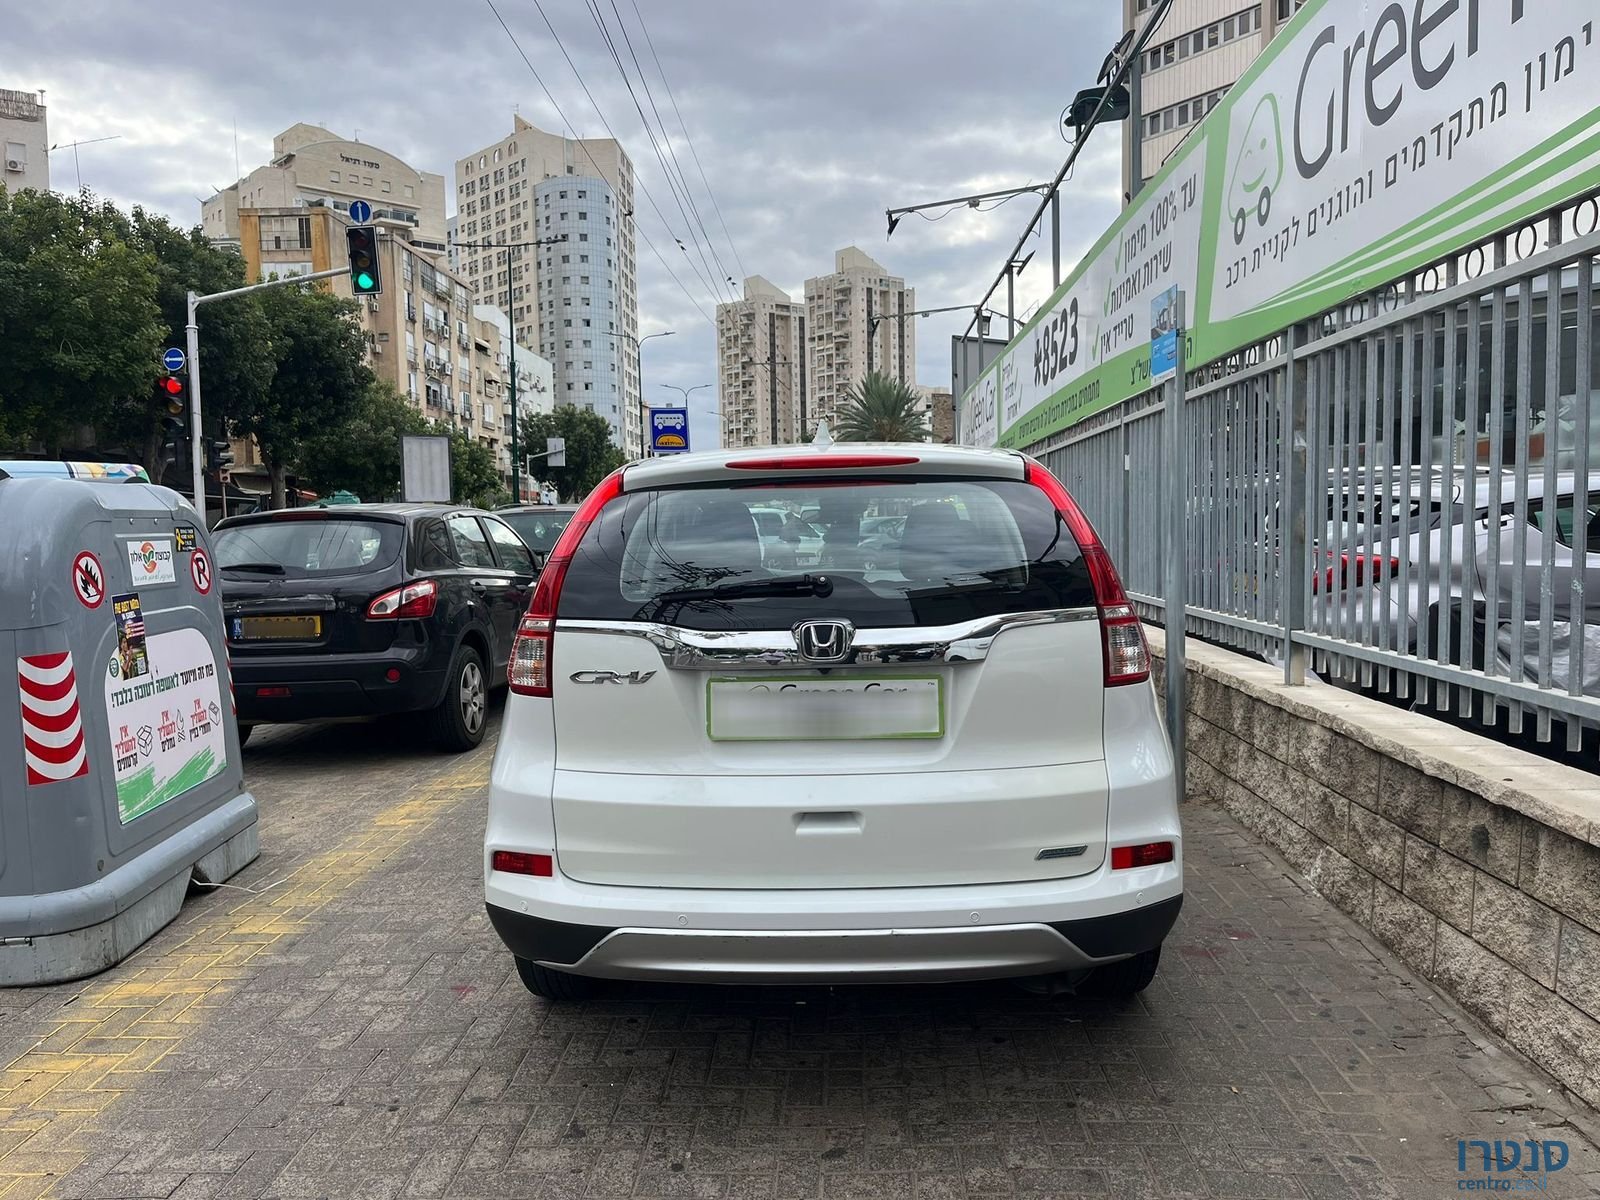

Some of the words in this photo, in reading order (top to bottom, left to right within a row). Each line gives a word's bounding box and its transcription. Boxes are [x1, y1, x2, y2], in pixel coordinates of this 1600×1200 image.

[1385, 81, 1507, 189] מתקדמים
[1181, 173, 1197, 212] עד
[1307, 169, 1373, 238] והוגנים
[1149, 189, 1177, 242] 100%
[1124, 223, 1147, 274] מימון
[1251, 215, 1300, 273] לקניית
[1142, 240, 1172, 290] שירות
[1225, 256, 1247, 289] רכב
[1110, 267, 1141, 316] ואמינות
[1100, 329, 1112, 366] אין
[1112, 313, 1134, 349] טרייד
[155, 672, 179, 694] לאשפה
[180, 667, 197, 686] מיועד
[197, 665, 205, 680] זה
[206, 663, 214, 678] פח
[569, 669, 658, 685] CR-V
[111, 687, 134, 708] בלבד!
[193, 698, 201, 712] אין
[119, 724, 129, 741] אין
[161, 709, 170, 724] אין
[114, 736, 137, 758] להשליך
